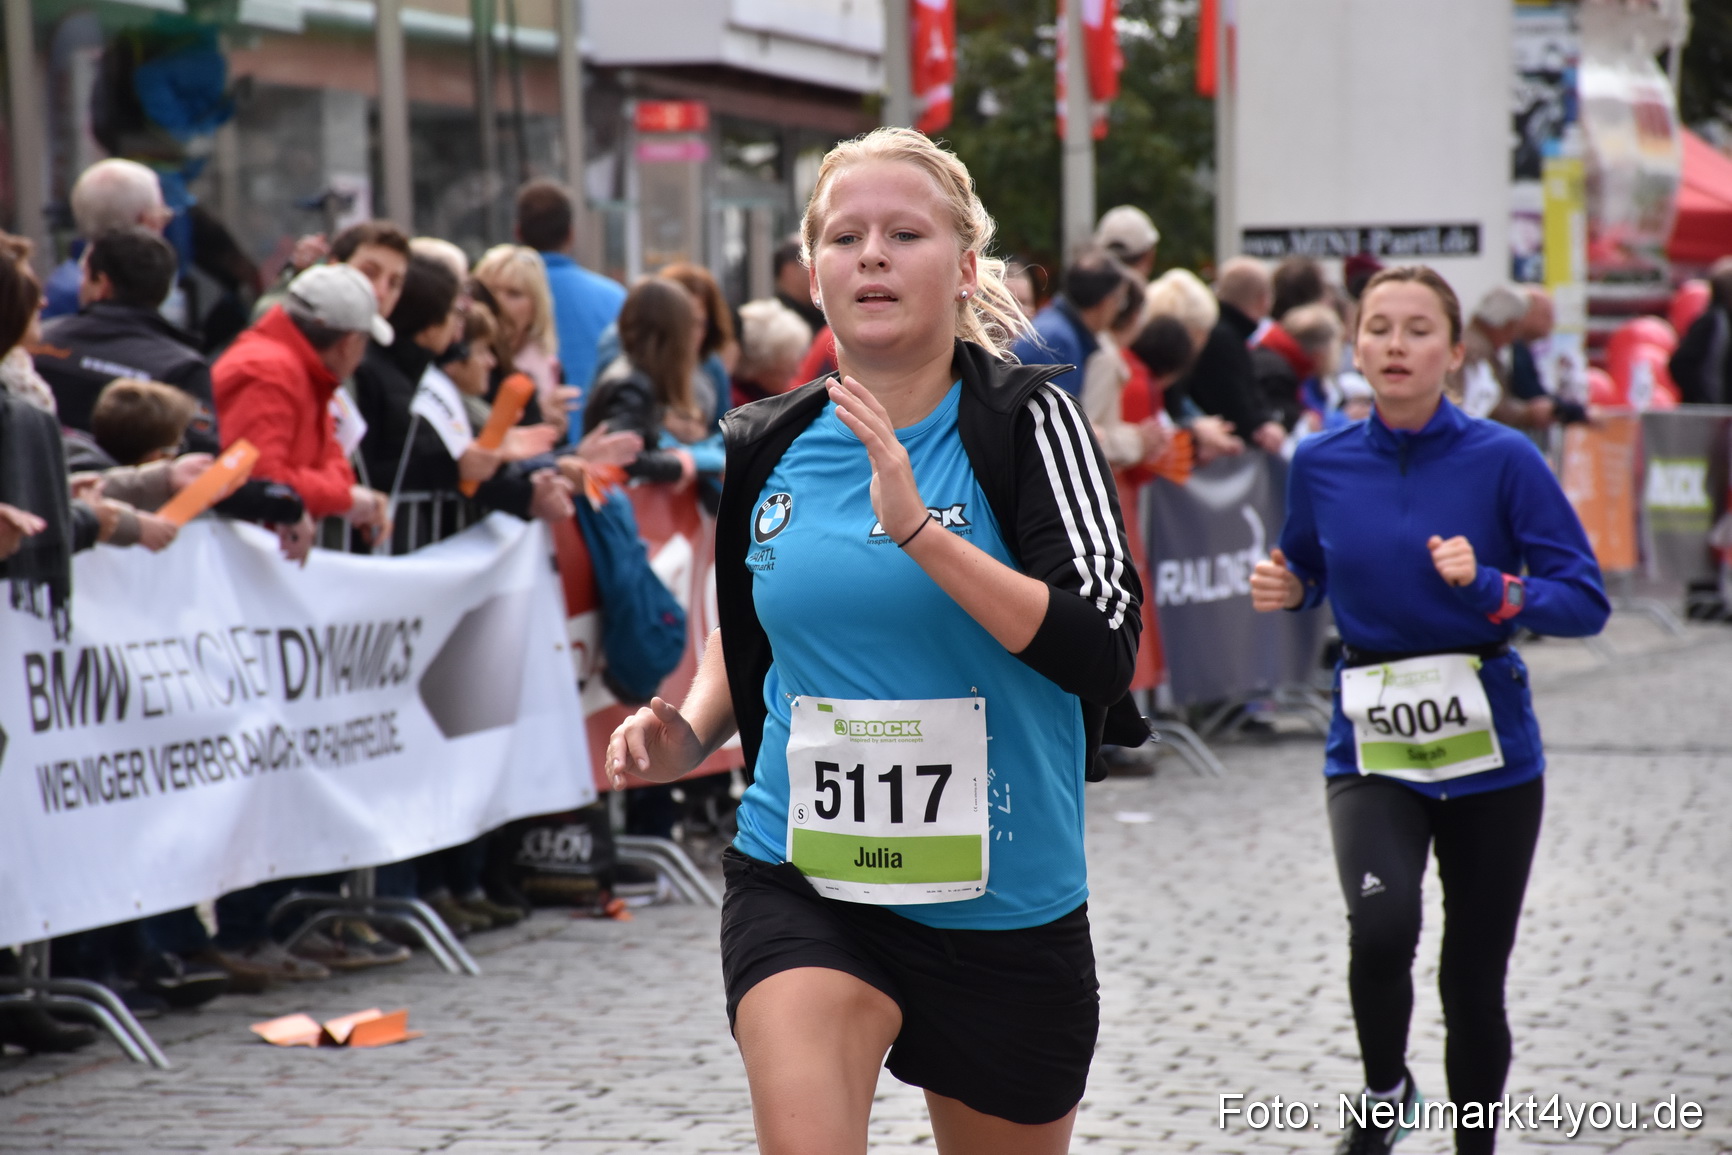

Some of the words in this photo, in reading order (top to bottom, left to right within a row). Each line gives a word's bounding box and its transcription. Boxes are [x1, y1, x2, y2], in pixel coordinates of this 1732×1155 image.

[761, 493, 793, 512] BMW
[24, 645, 130, 734] BMW
[849, 720, 923, 737] BOCK
[1367, 696, 1468, 737] 5004
[36, 749, 150, 815] WENIGER
[814, 760, 953, 824] 5117
[853, 846, 903, 868] Julia
